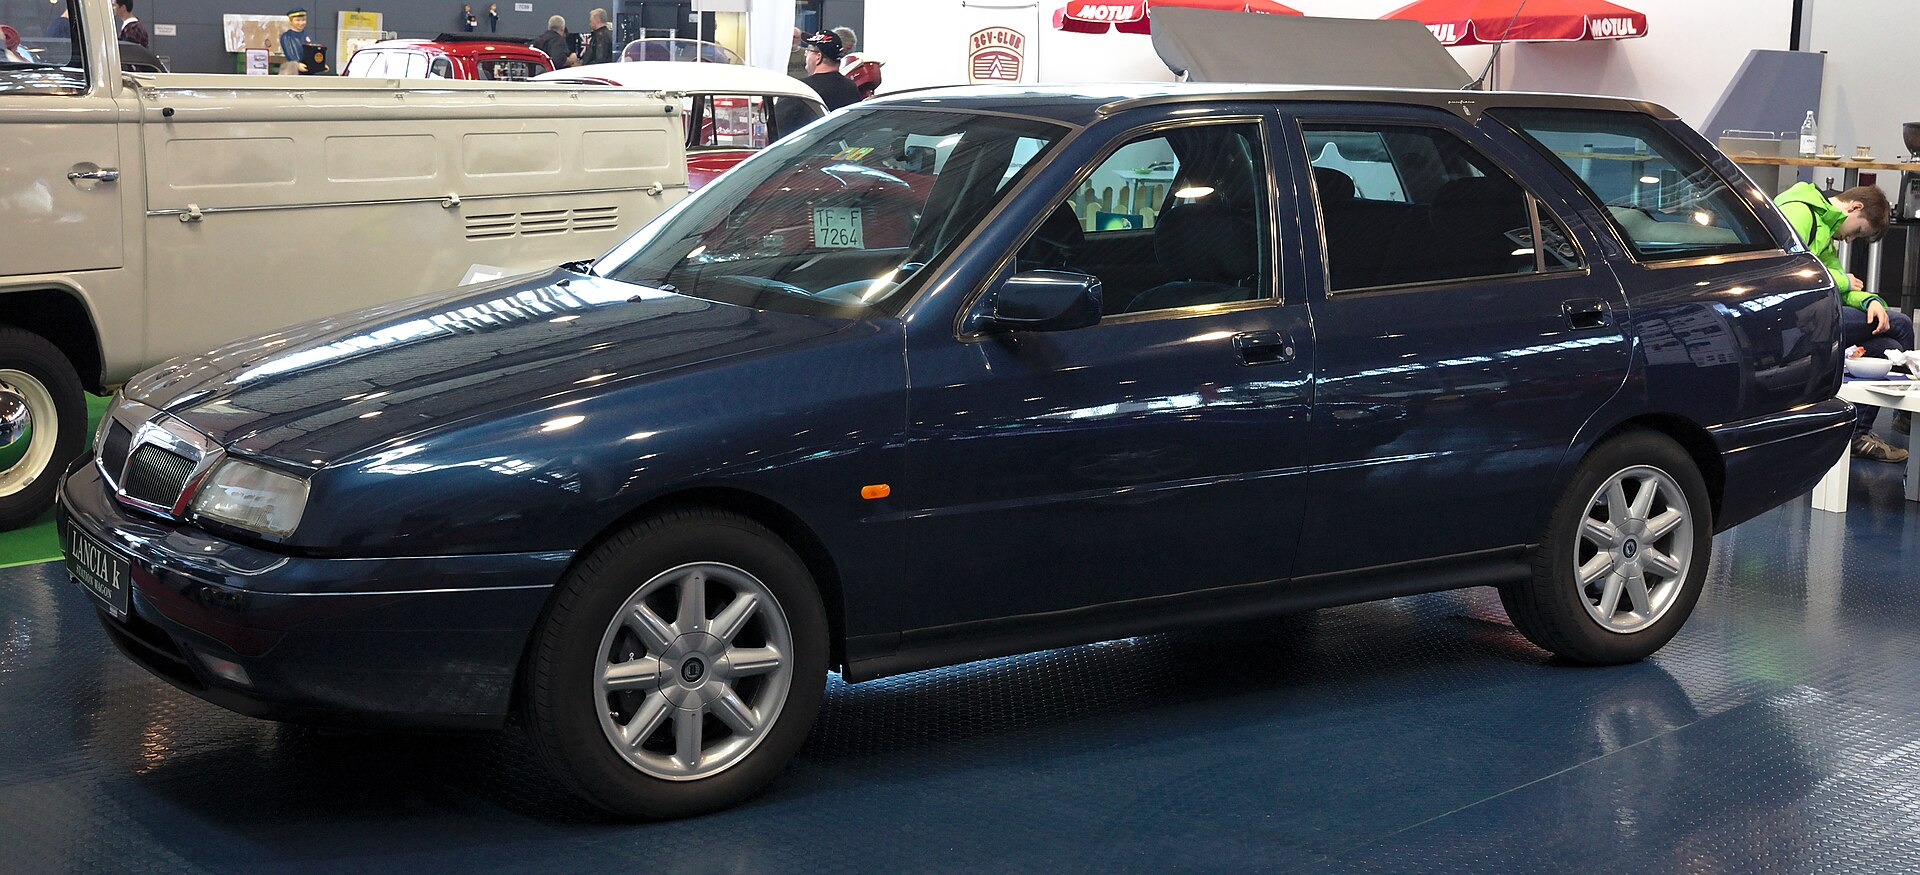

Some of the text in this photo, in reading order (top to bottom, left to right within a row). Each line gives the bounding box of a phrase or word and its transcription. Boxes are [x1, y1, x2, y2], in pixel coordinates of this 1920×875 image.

[1592, 17, 1637, 36] MOTUL
[820, 228, 858, 246] 7264
[71, 530, 109, 583] LANCIA
[93, 578, 113, 600] WAGON
